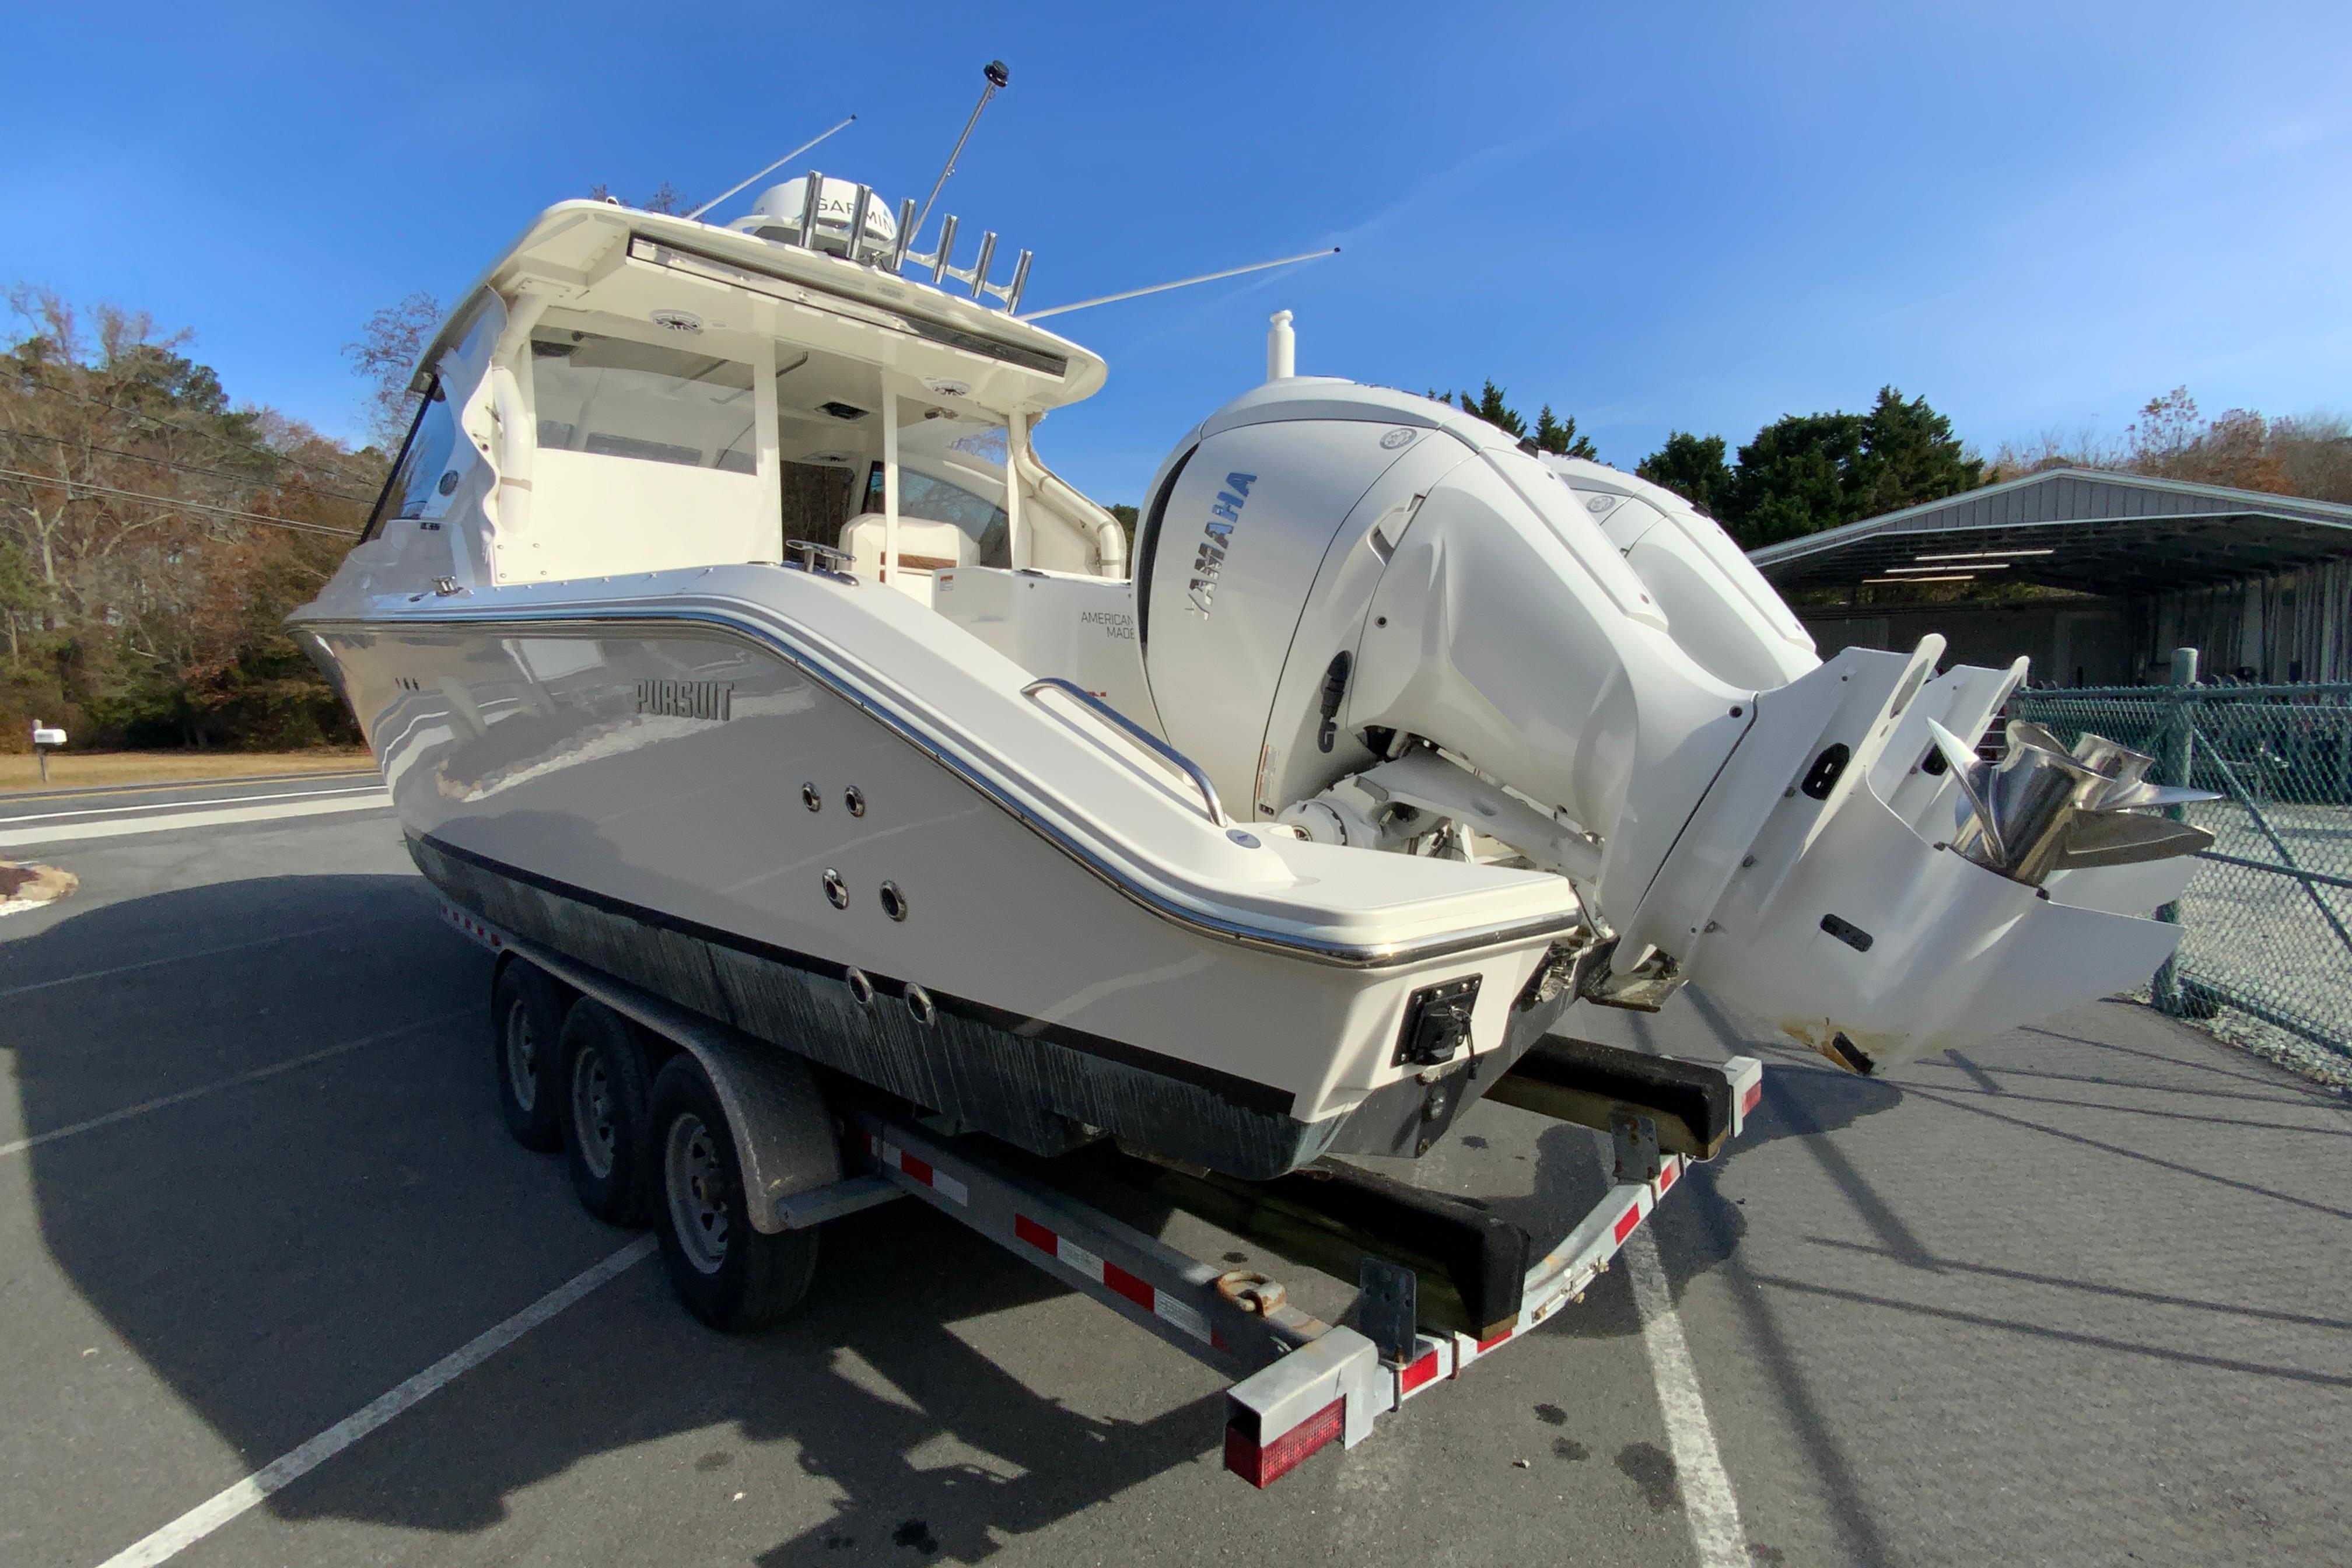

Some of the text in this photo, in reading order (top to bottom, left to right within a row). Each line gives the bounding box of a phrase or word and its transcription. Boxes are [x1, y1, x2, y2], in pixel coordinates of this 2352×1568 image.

[1185, 472, 1258, 621] YAMAHA
[1081, 611, 1133, 626] AMERICAN
[1107, 626, 1135, 640] MADE
[636, 680, 734, 721] PURSUIT
